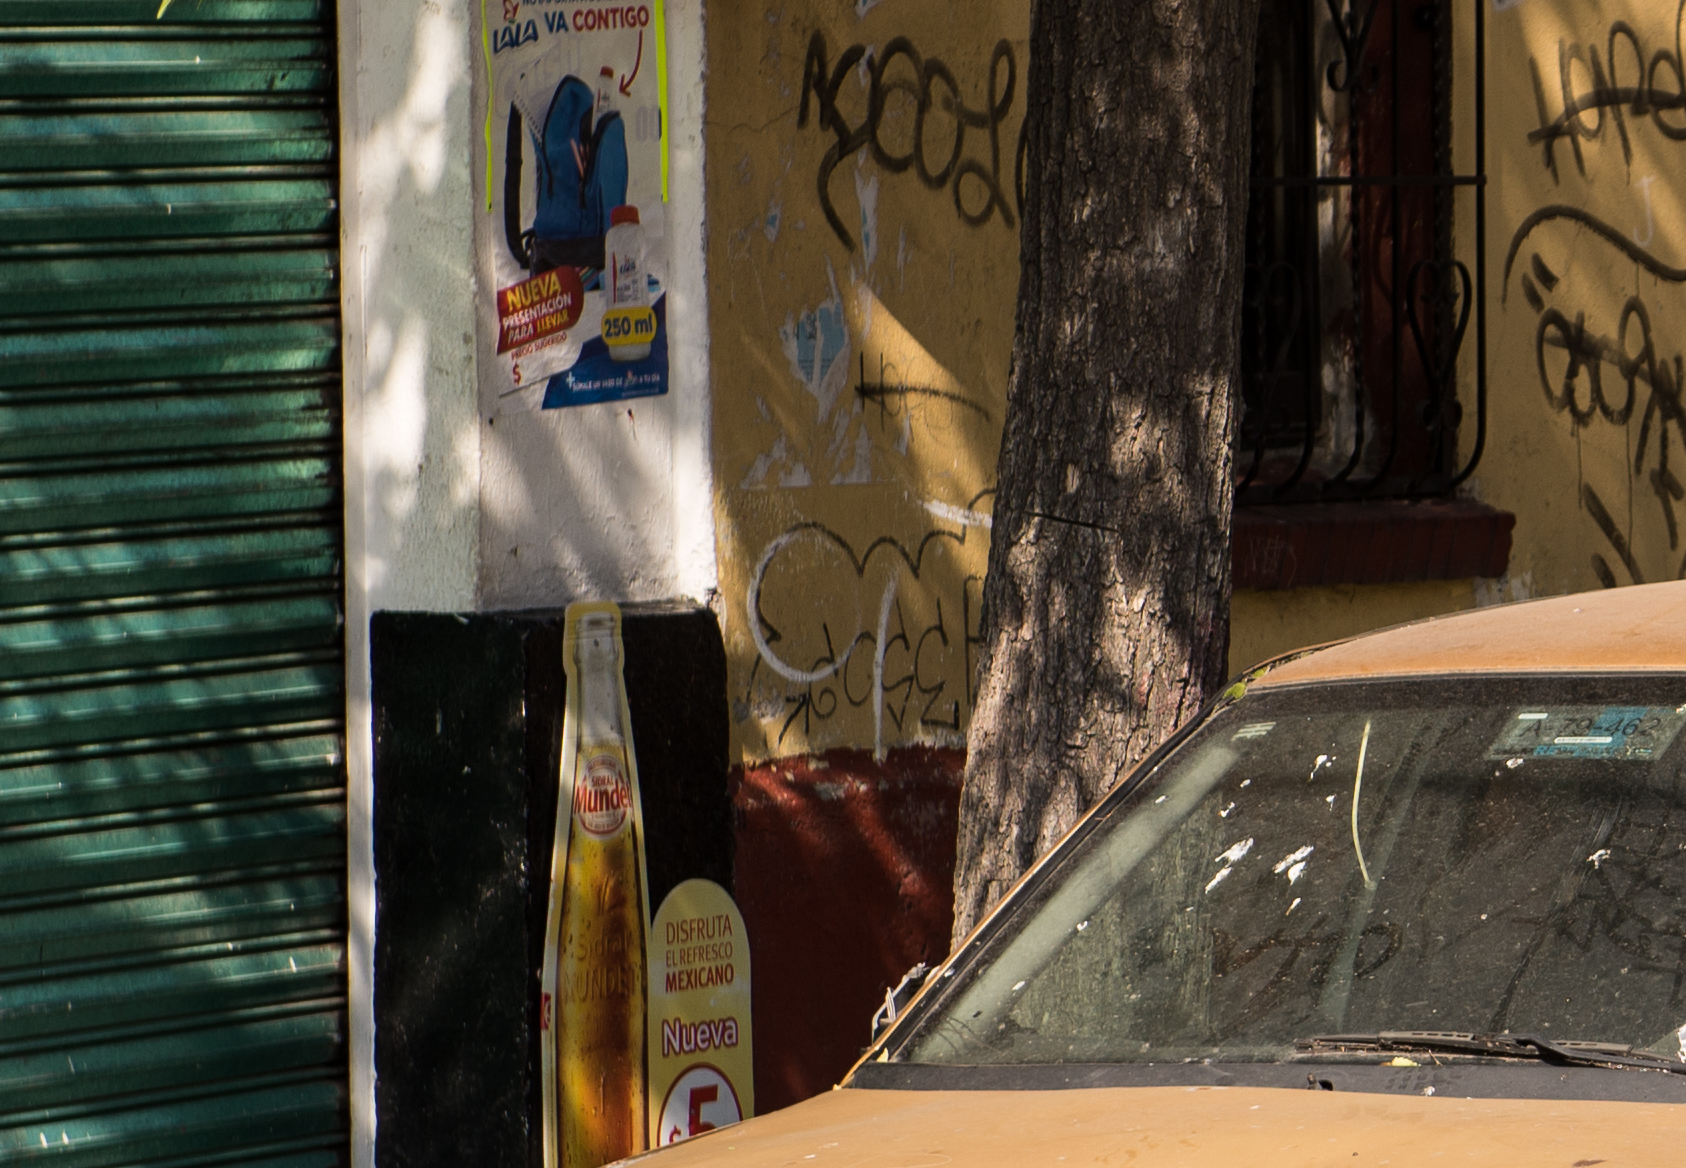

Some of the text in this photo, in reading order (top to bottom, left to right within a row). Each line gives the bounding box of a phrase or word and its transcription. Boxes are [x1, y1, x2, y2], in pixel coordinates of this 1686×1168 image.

[544, 10, 569, 34] VA
[572, 5, 650, 33] CONTIGO
[506, 271, 562, 312] NUEVA
[502, 291, 572, 332] PRESENTACIÓN
[508, 310, 570, 345] PARA LLEVAR
[604, 312, 653, 338] 250 ml
[1517, 716, 1662, 739] A-79-462
[665, 913, 734, 945] DISFRUTA
[665, 941, 734, 968] EL REFRESCO
[665, 962, 735, 994] MEXICANO
[662, 1017, 739, 1057] Nueva
